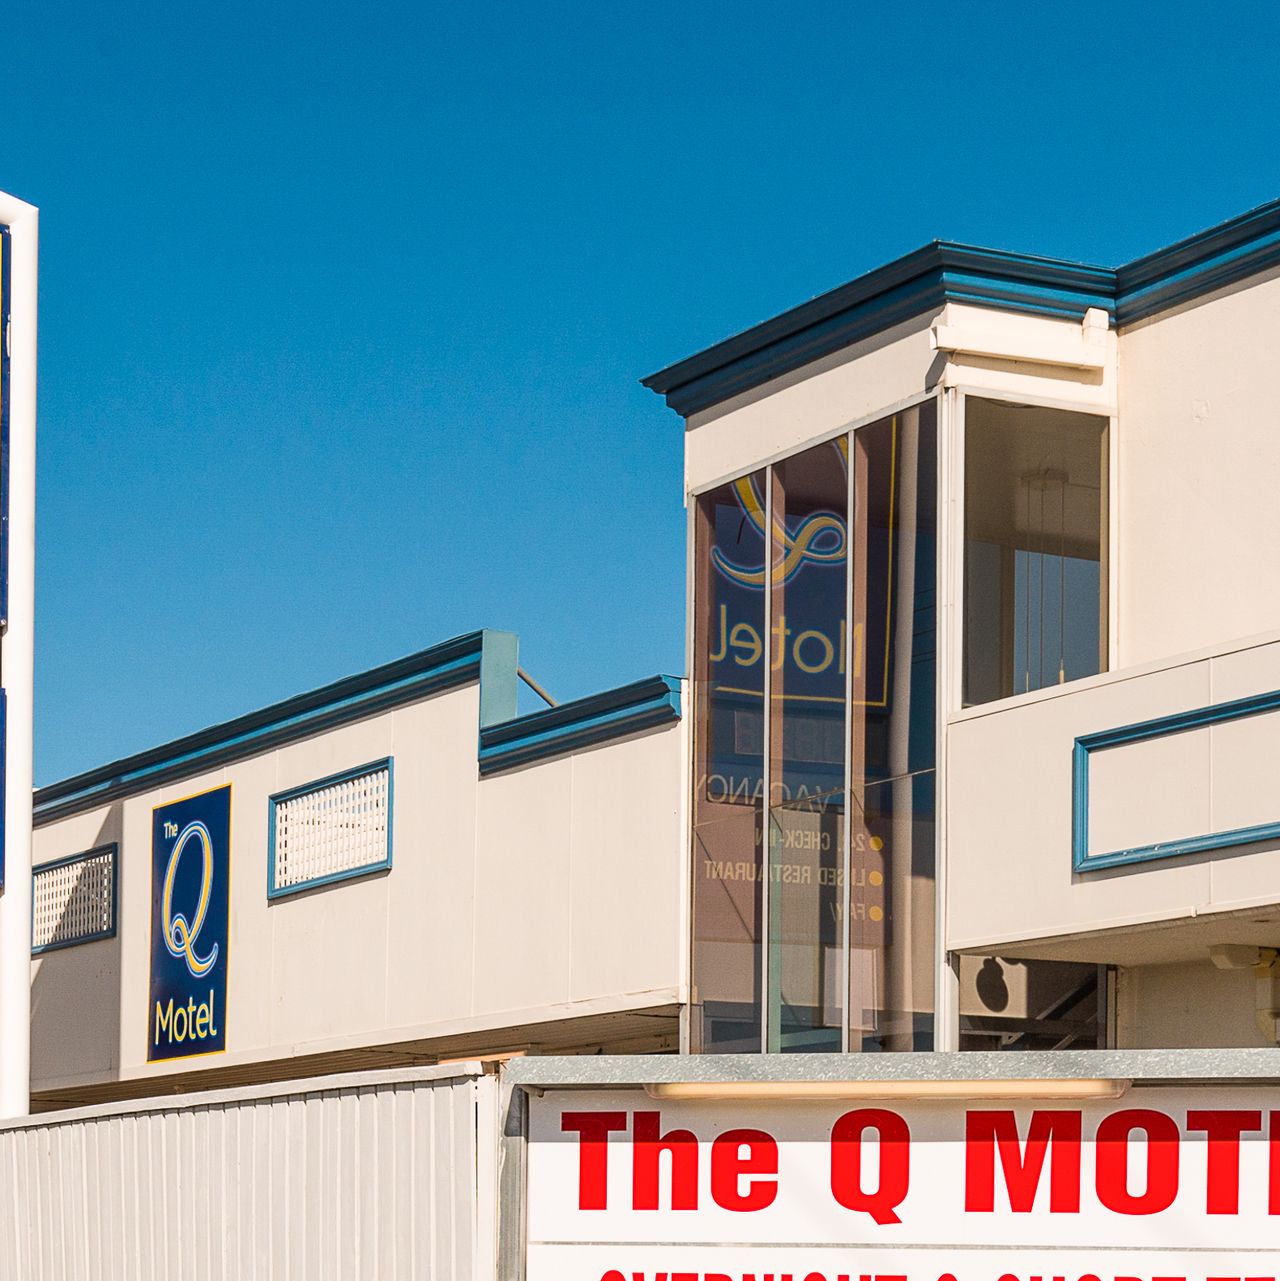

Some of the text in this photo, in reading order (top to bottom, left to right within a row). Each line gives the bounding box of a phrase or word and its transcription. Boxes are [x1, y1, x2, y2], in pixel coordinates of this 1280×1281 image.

[163, 821, 179, 840] The
[162, 820, 219, 978] Q
[155, 989, 218, 1046] Motel
[562, 1111, 780, 1212] The
[830, 1109, 911, 1225] Q
